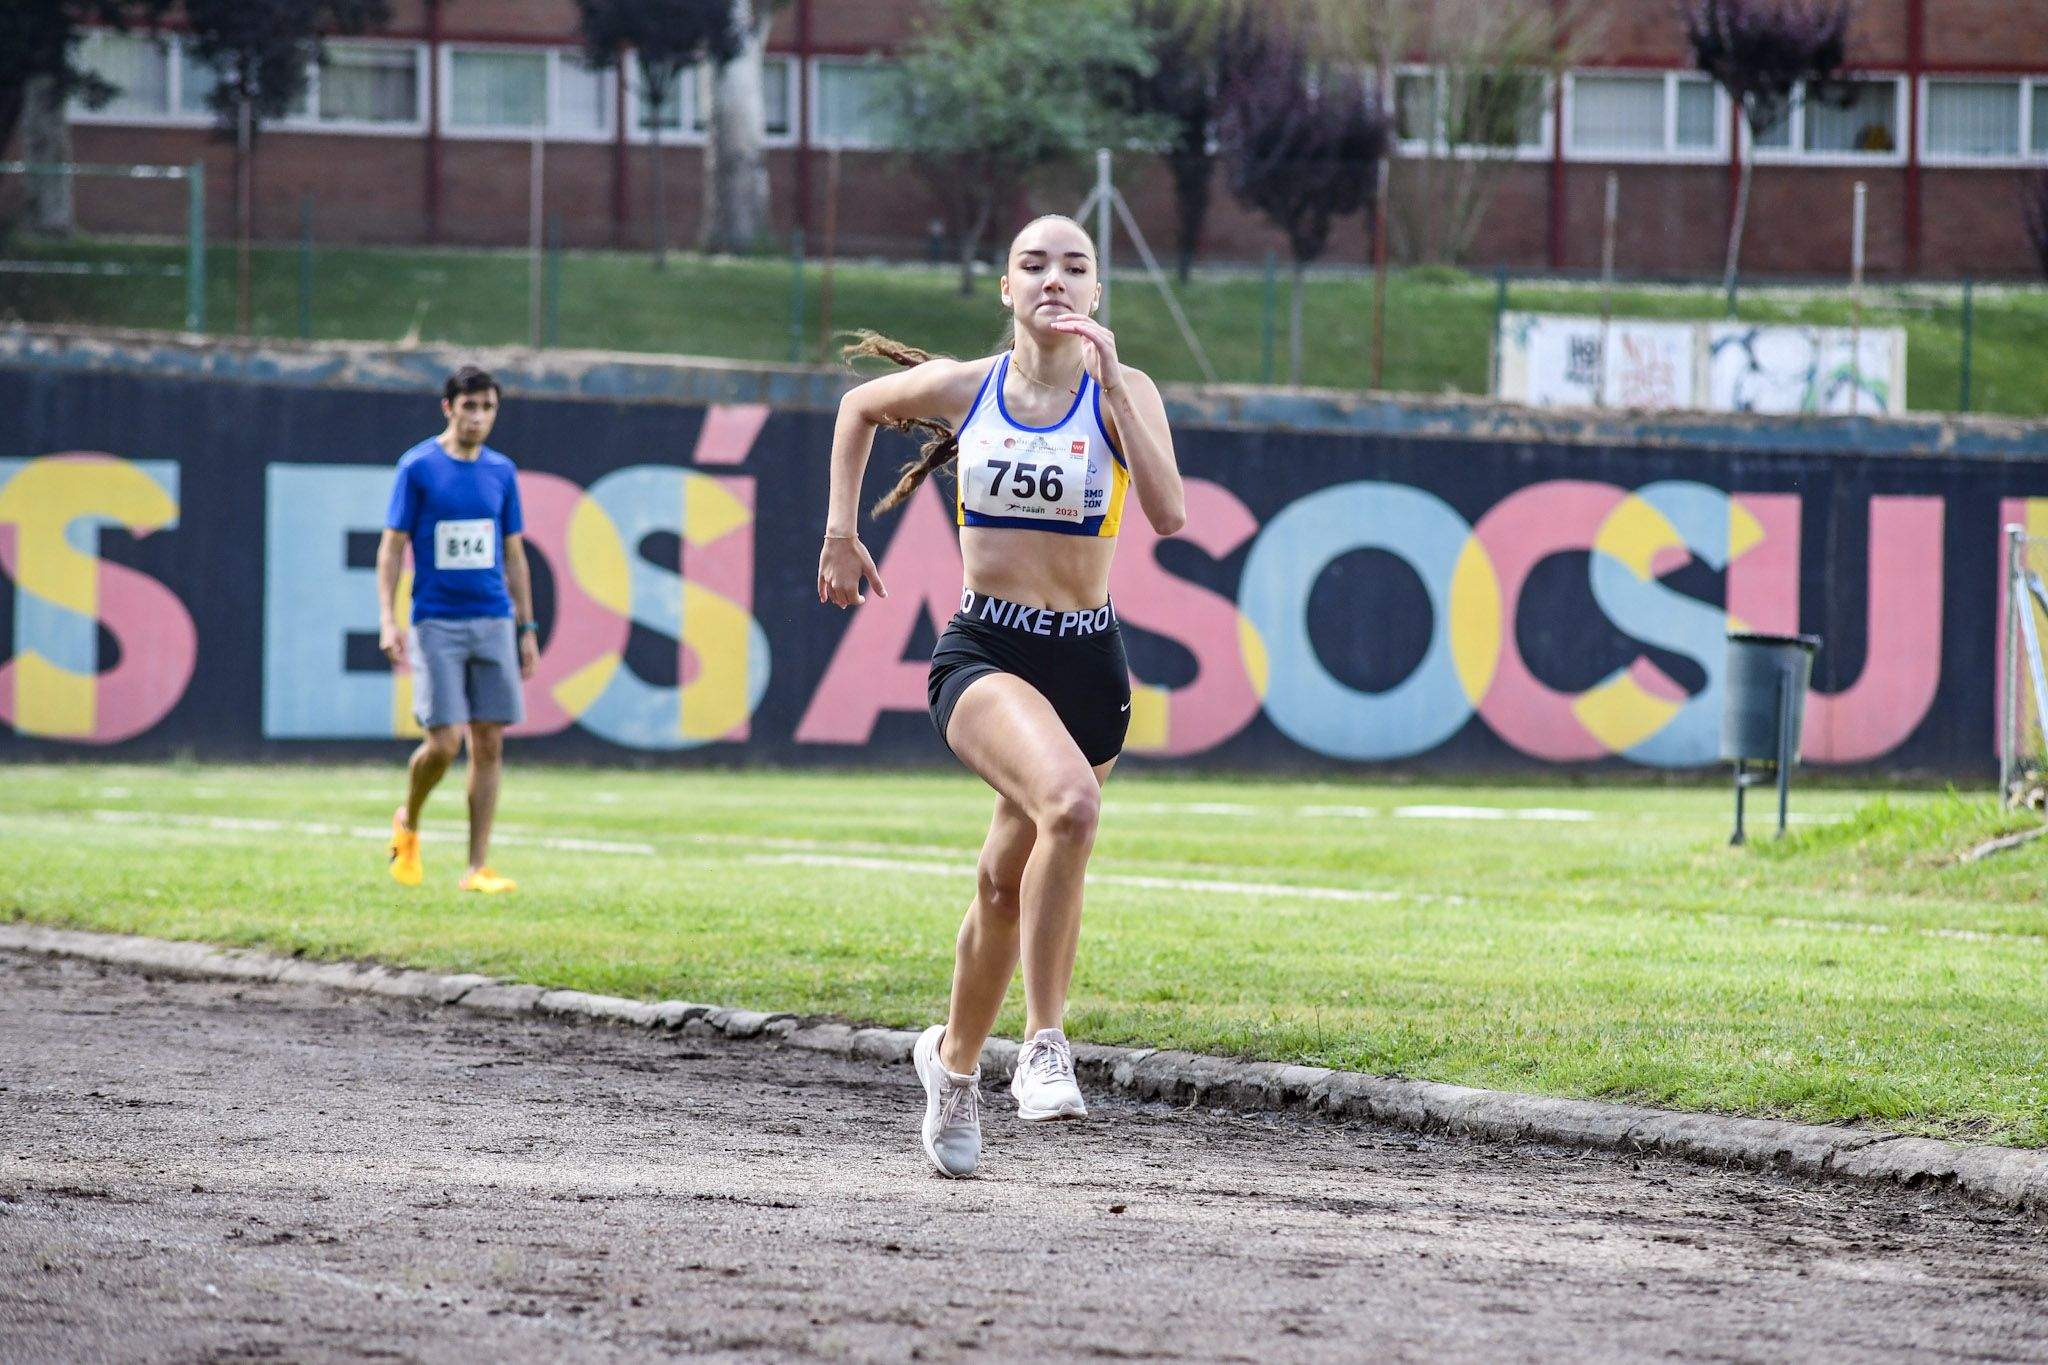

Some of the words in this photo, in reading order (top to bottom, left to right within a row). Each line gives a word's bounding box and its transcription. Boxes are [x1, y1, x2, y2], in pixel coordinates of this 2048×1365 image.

[987, 459, 1064, 502] 756
[1055, 507, 1078, 518] 2023
[447, 537, 484, 557] 814
[979, 596, 1056, 636] NIKE
[1058, 605, 1110, 637] PRO
